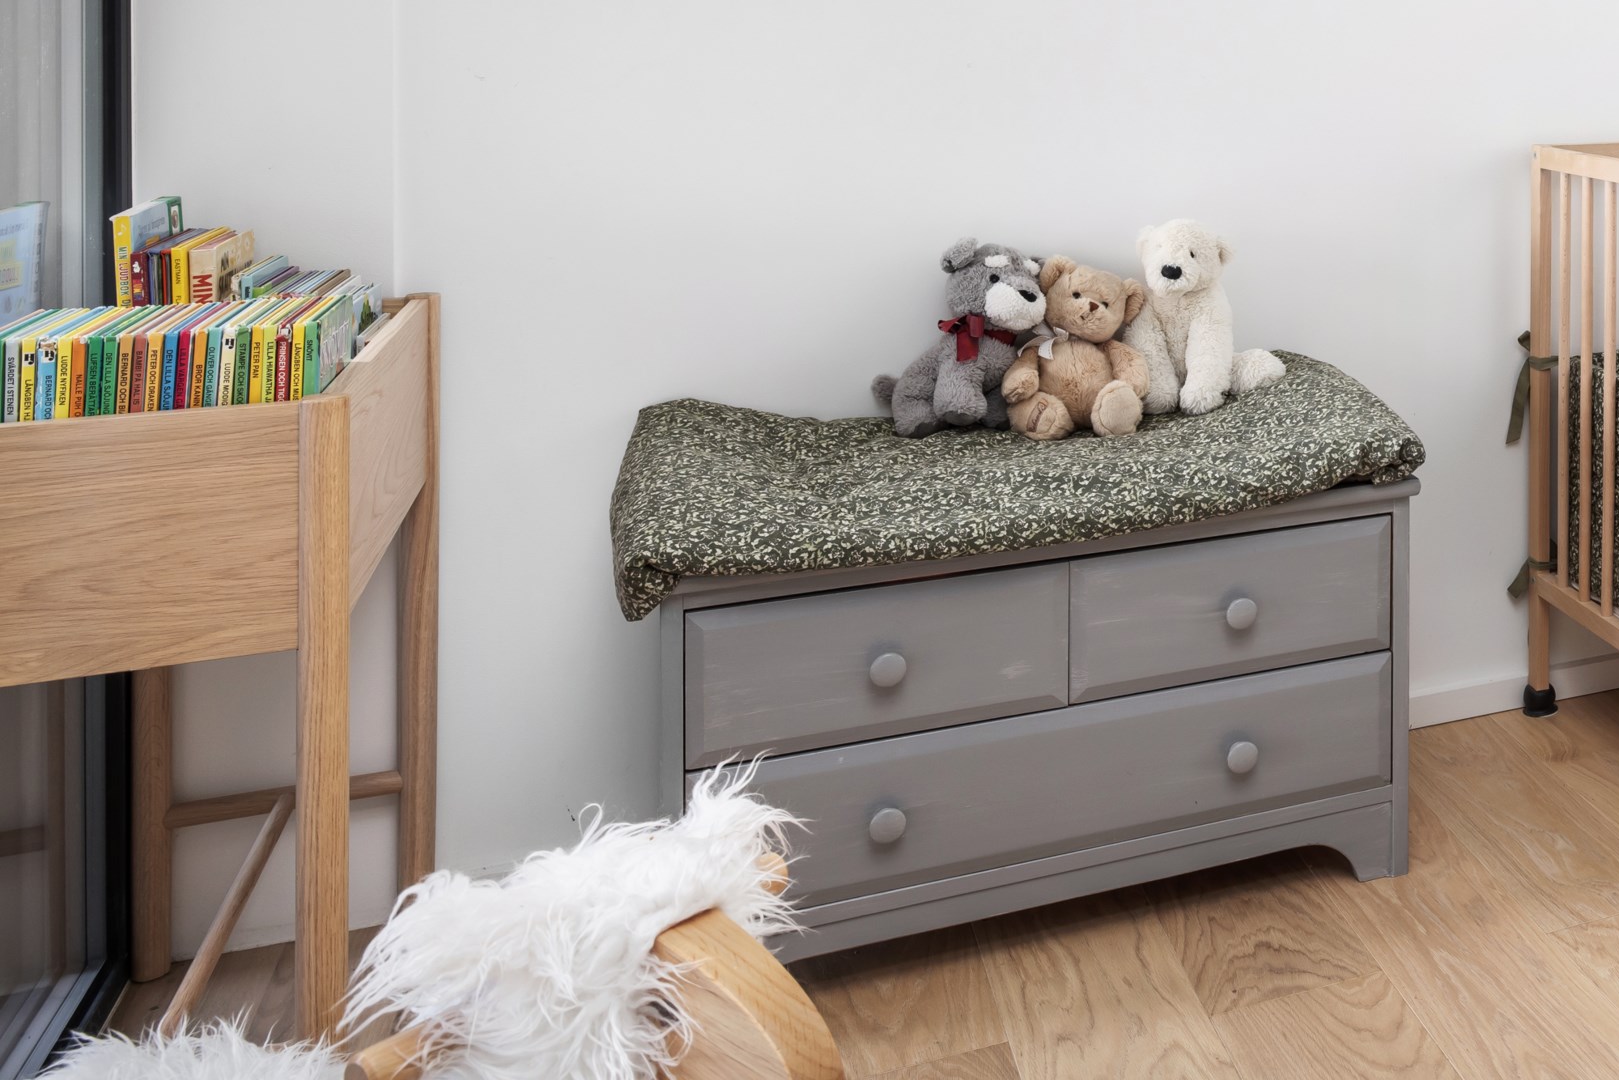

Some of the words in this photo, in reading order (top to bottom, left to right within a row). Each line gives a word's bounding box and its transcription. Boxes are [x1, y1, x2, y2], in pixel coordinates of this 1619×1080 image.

[118, 246, 127, 260] MIN
[118, 262, 130, 296] LJUDBOK
[174, 258, 182, 285] EASTMAN
[105, 352, 113, 366] DEN
[135, 350, 143, 372] BAMBI
[207, 346, 215, 369] OLIVER
[238, 343, 247, 370] STAMPE
[252, 341, 260, 364] PETER
[266, 341, 274, 360] LILLA
[278, 341, 287, 371] PRINSEN
[293, 343, 302, 372] LÅNGBEN
[305, 340, 314, 362] SNÖVIT
[7, 357, 16, 386] SVÄRDET
[60, 355, 68, 377] LUDDE
[89, 353, 98, 379] LUFSEN
[104, 367, 112, 385] LILLA
[120, 353, 129, 387] BERNARD
[195, 364, 203, 384] BROR
[206, 369, 214, 384] OCH
[223, 362, 231, 384] LUDDE
[252, 365, 260, 378] PAN
[75, 374, 83, 395] NALLE
[149, 370, 157, 385] OCH
[237, 371, 245, 386] OCH
[265, 361, 273, 396] HIAWATHA
[278, 372, 286, 387] OCH
[293, 373, 301, 387] OCH
[24, 379, 33, 411] LÅNGBEN
[59, 377, 67, 406] NYFIKEN
[119, 388, 127, 404] OCH
[133, 384, 141, 398] HAL
[193, 385, 202, 407] KANIN
[221, 384, 230, 406] MODIG
[6, 389, 15, 416] STENEN
[74, 396, 82, 410] PUH
